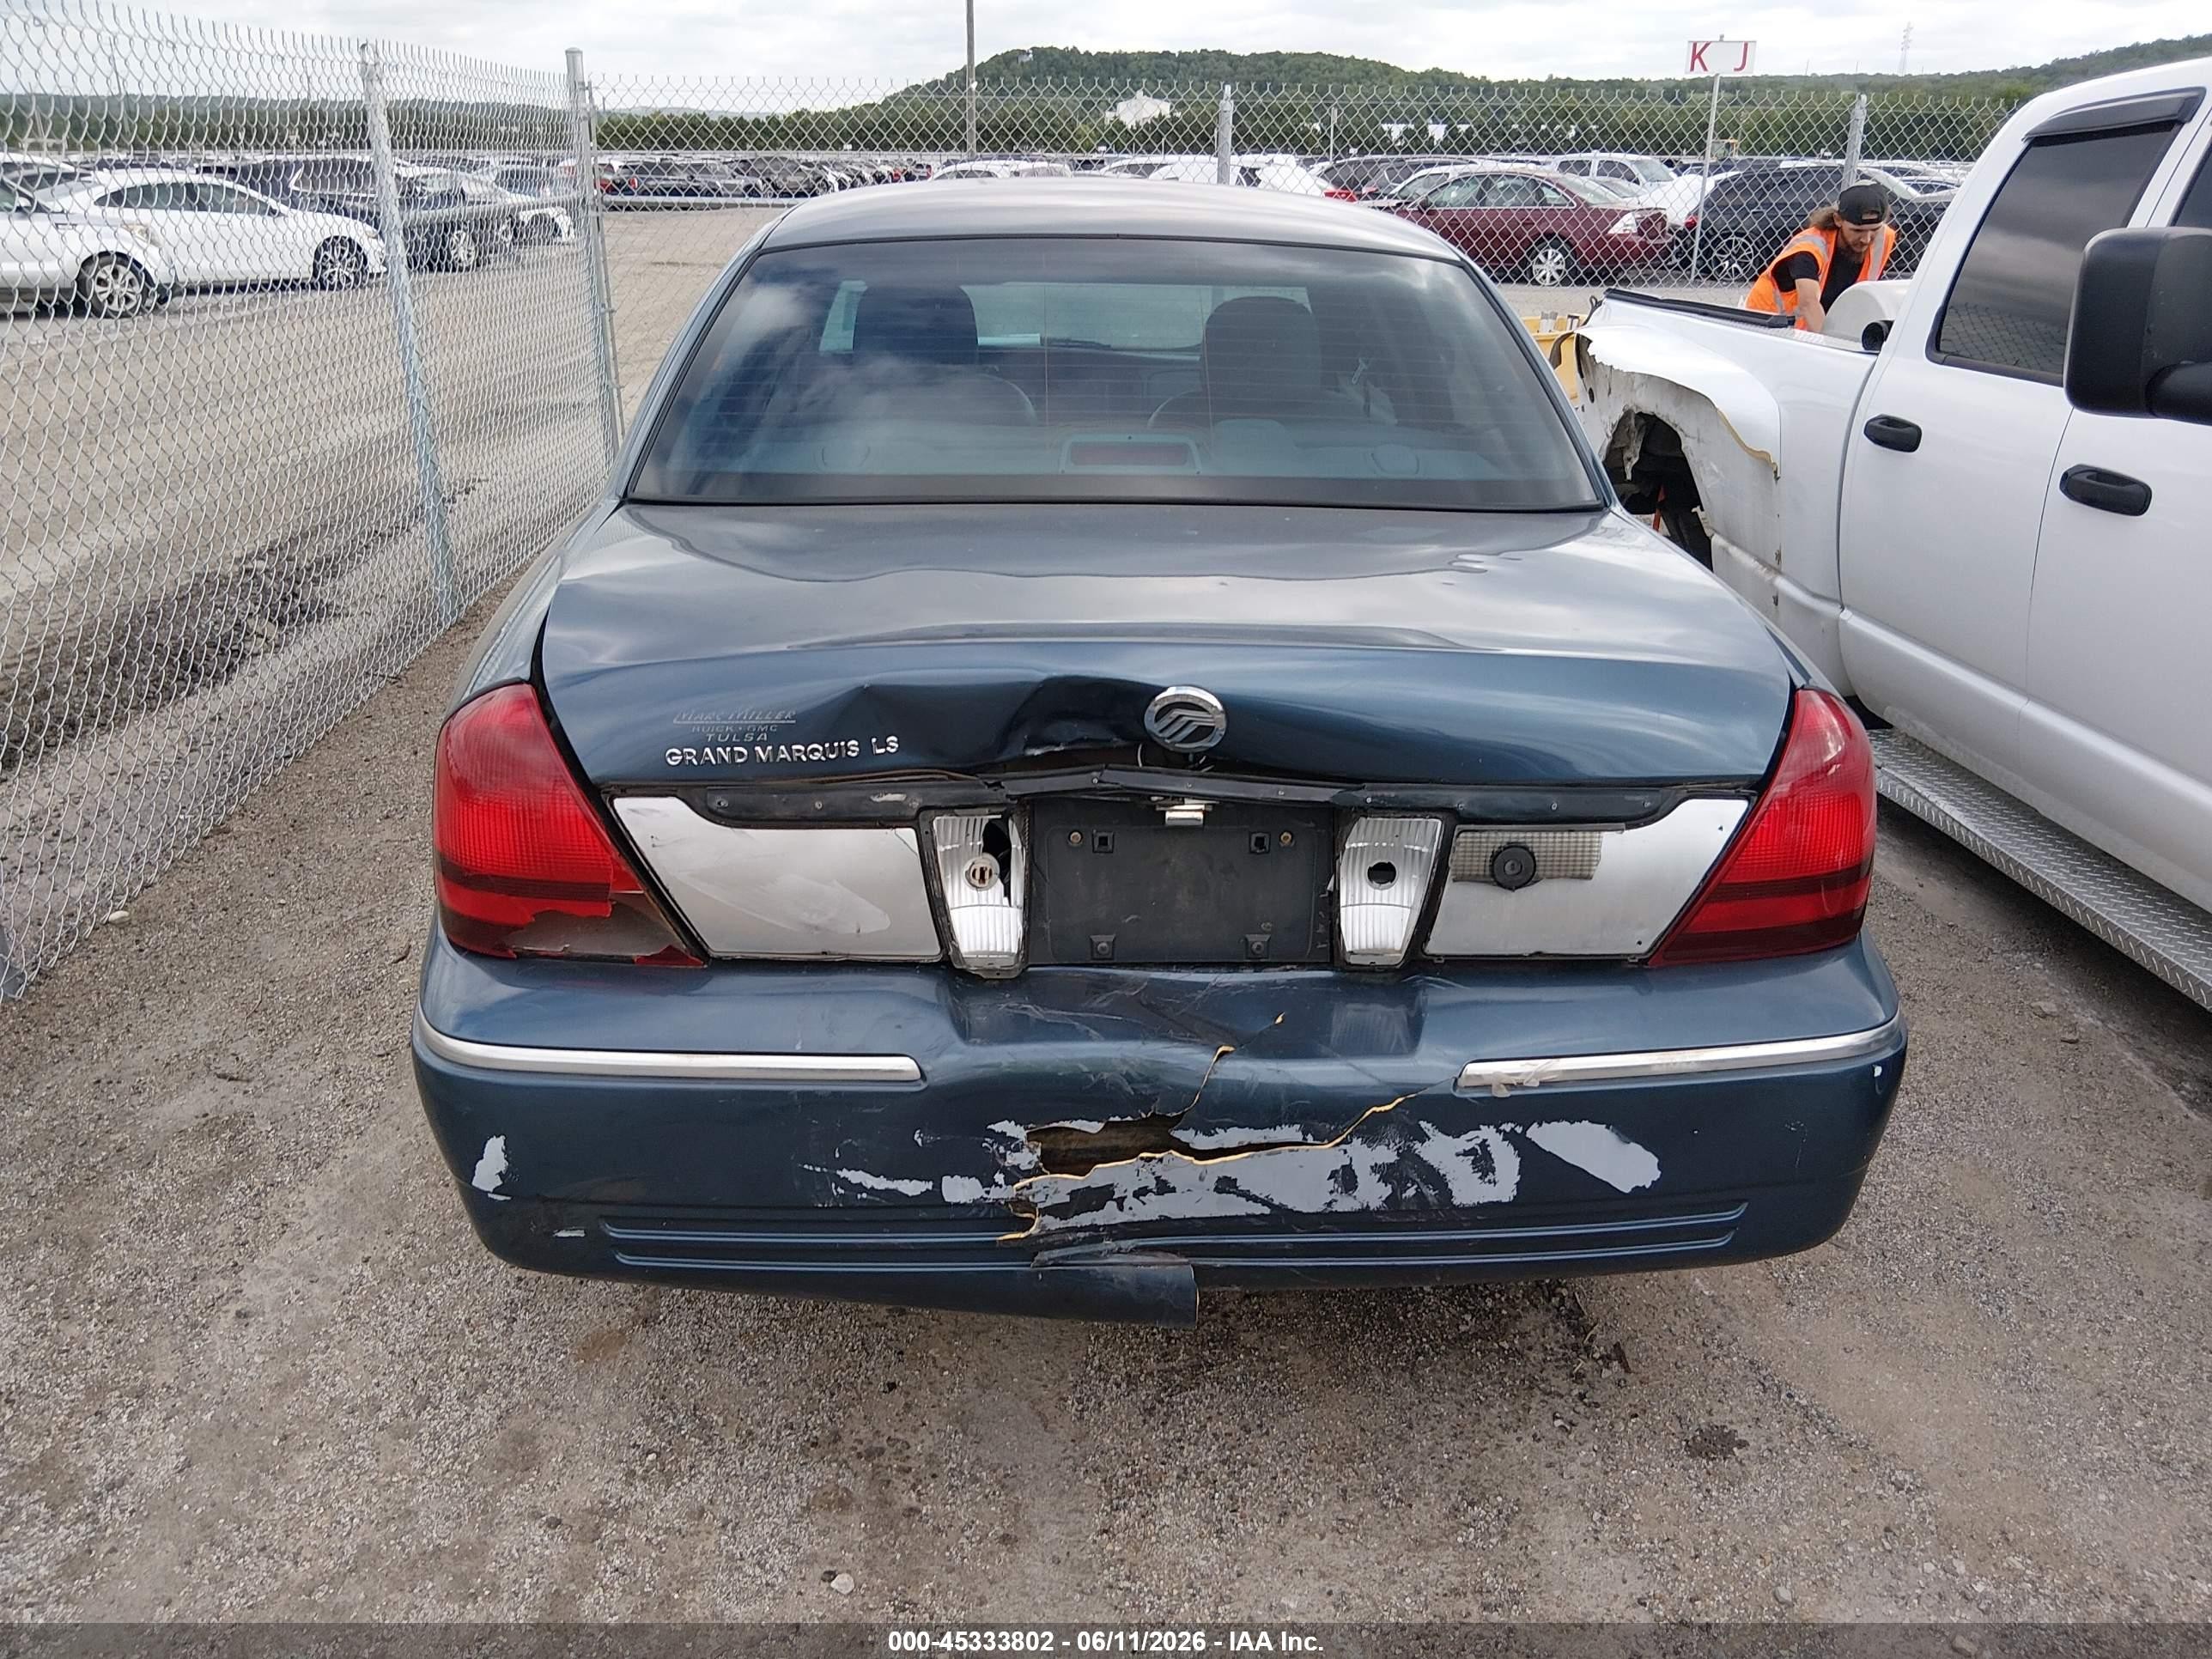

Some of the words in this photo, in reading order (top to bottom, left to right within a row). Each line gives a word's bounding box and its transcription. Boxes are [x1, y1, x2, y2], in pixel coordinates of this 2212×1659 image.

[1689, 41, 1711, 72] K
[1733, 41, 1748, 72] J
[665, 745, 749, 767] GRAND
[754, 739, 860, 764] MARQUIS
[871, 735, 900, 756] LS
[706, 732, 769, 743] TULSA
